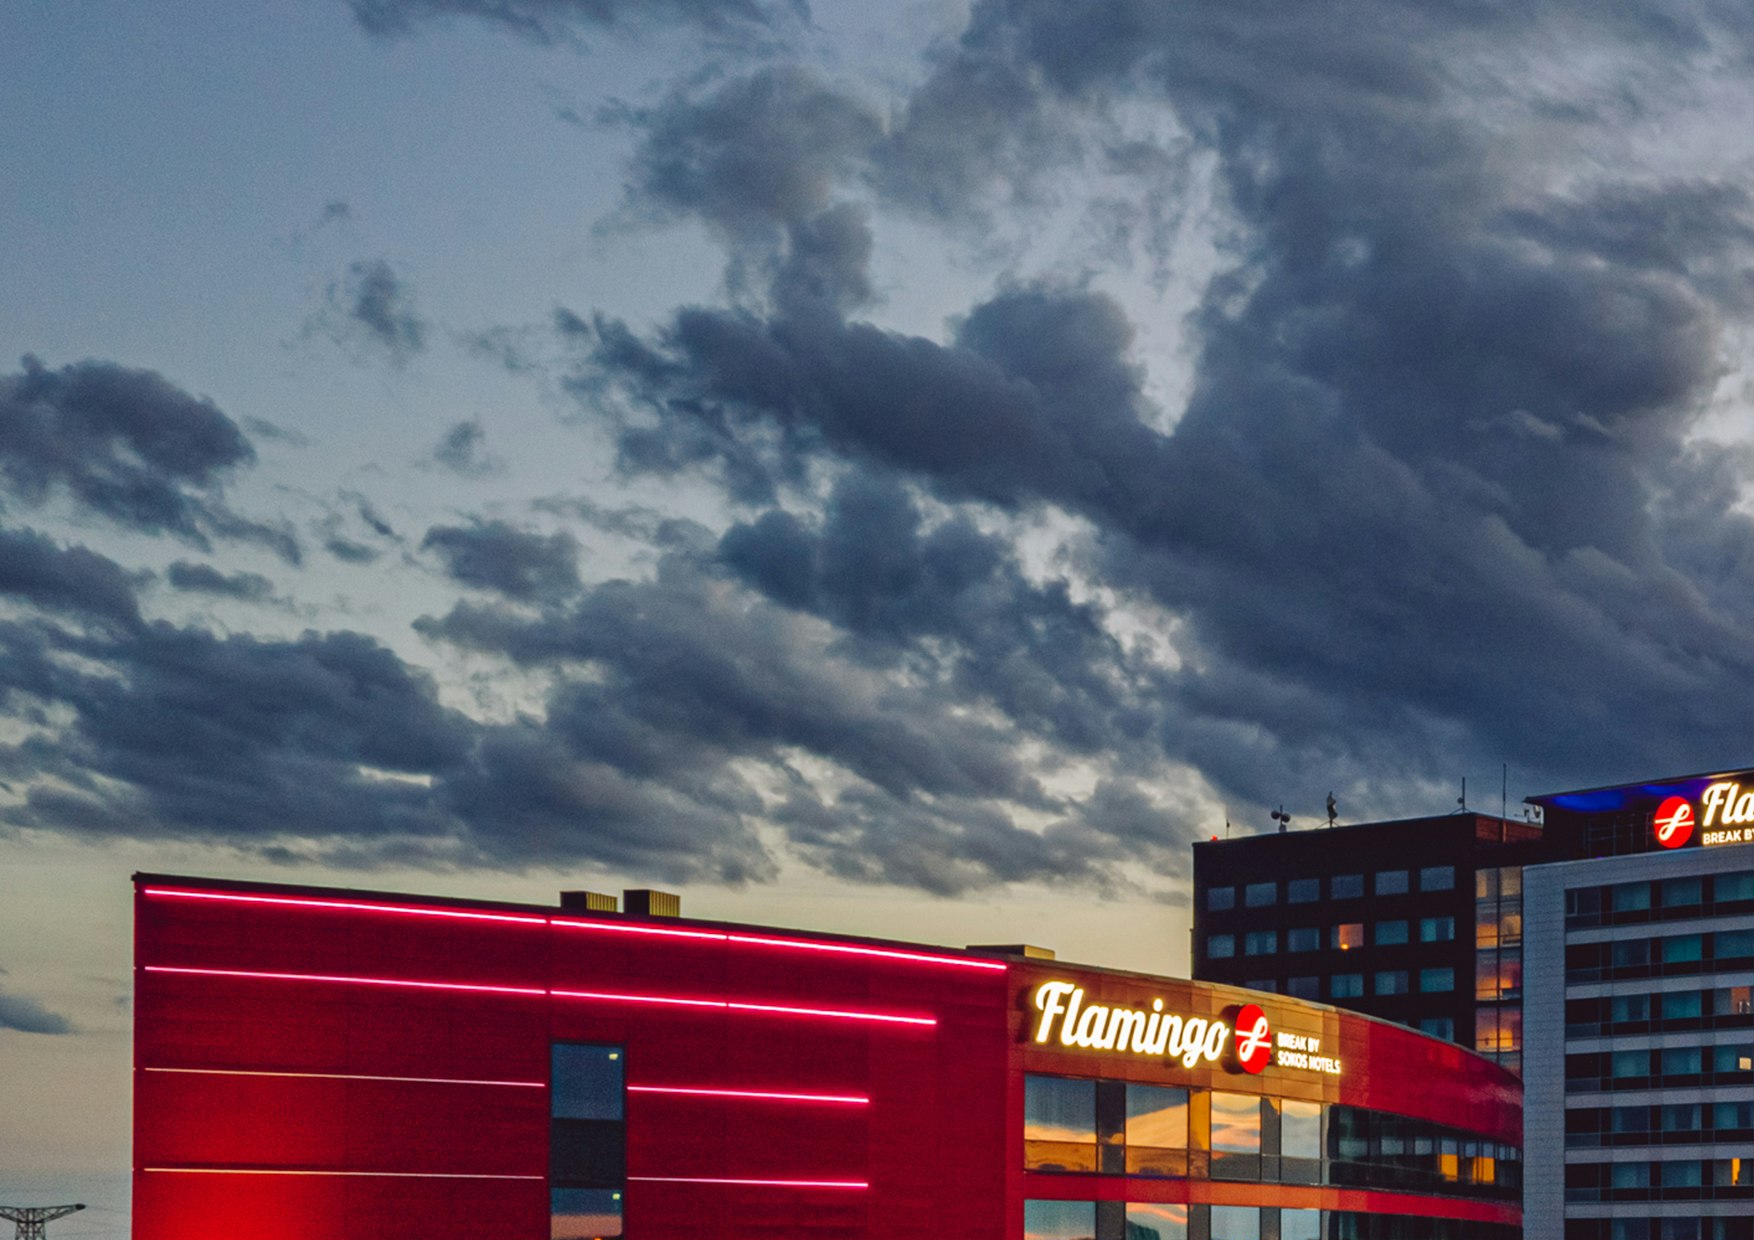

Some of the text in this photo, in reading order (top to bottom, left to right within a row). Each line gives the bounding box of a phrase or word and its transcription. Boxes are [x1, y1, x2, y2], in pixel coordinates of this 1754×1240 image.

[1702, 829, 1741, 846] BREAK
[1035, 981, 1230, 1069] Flamingo
[1277, 1032, 1320, 1053] BREAK BY
[1277, 1050, 1341, 1075] SOKOS HOTELS
